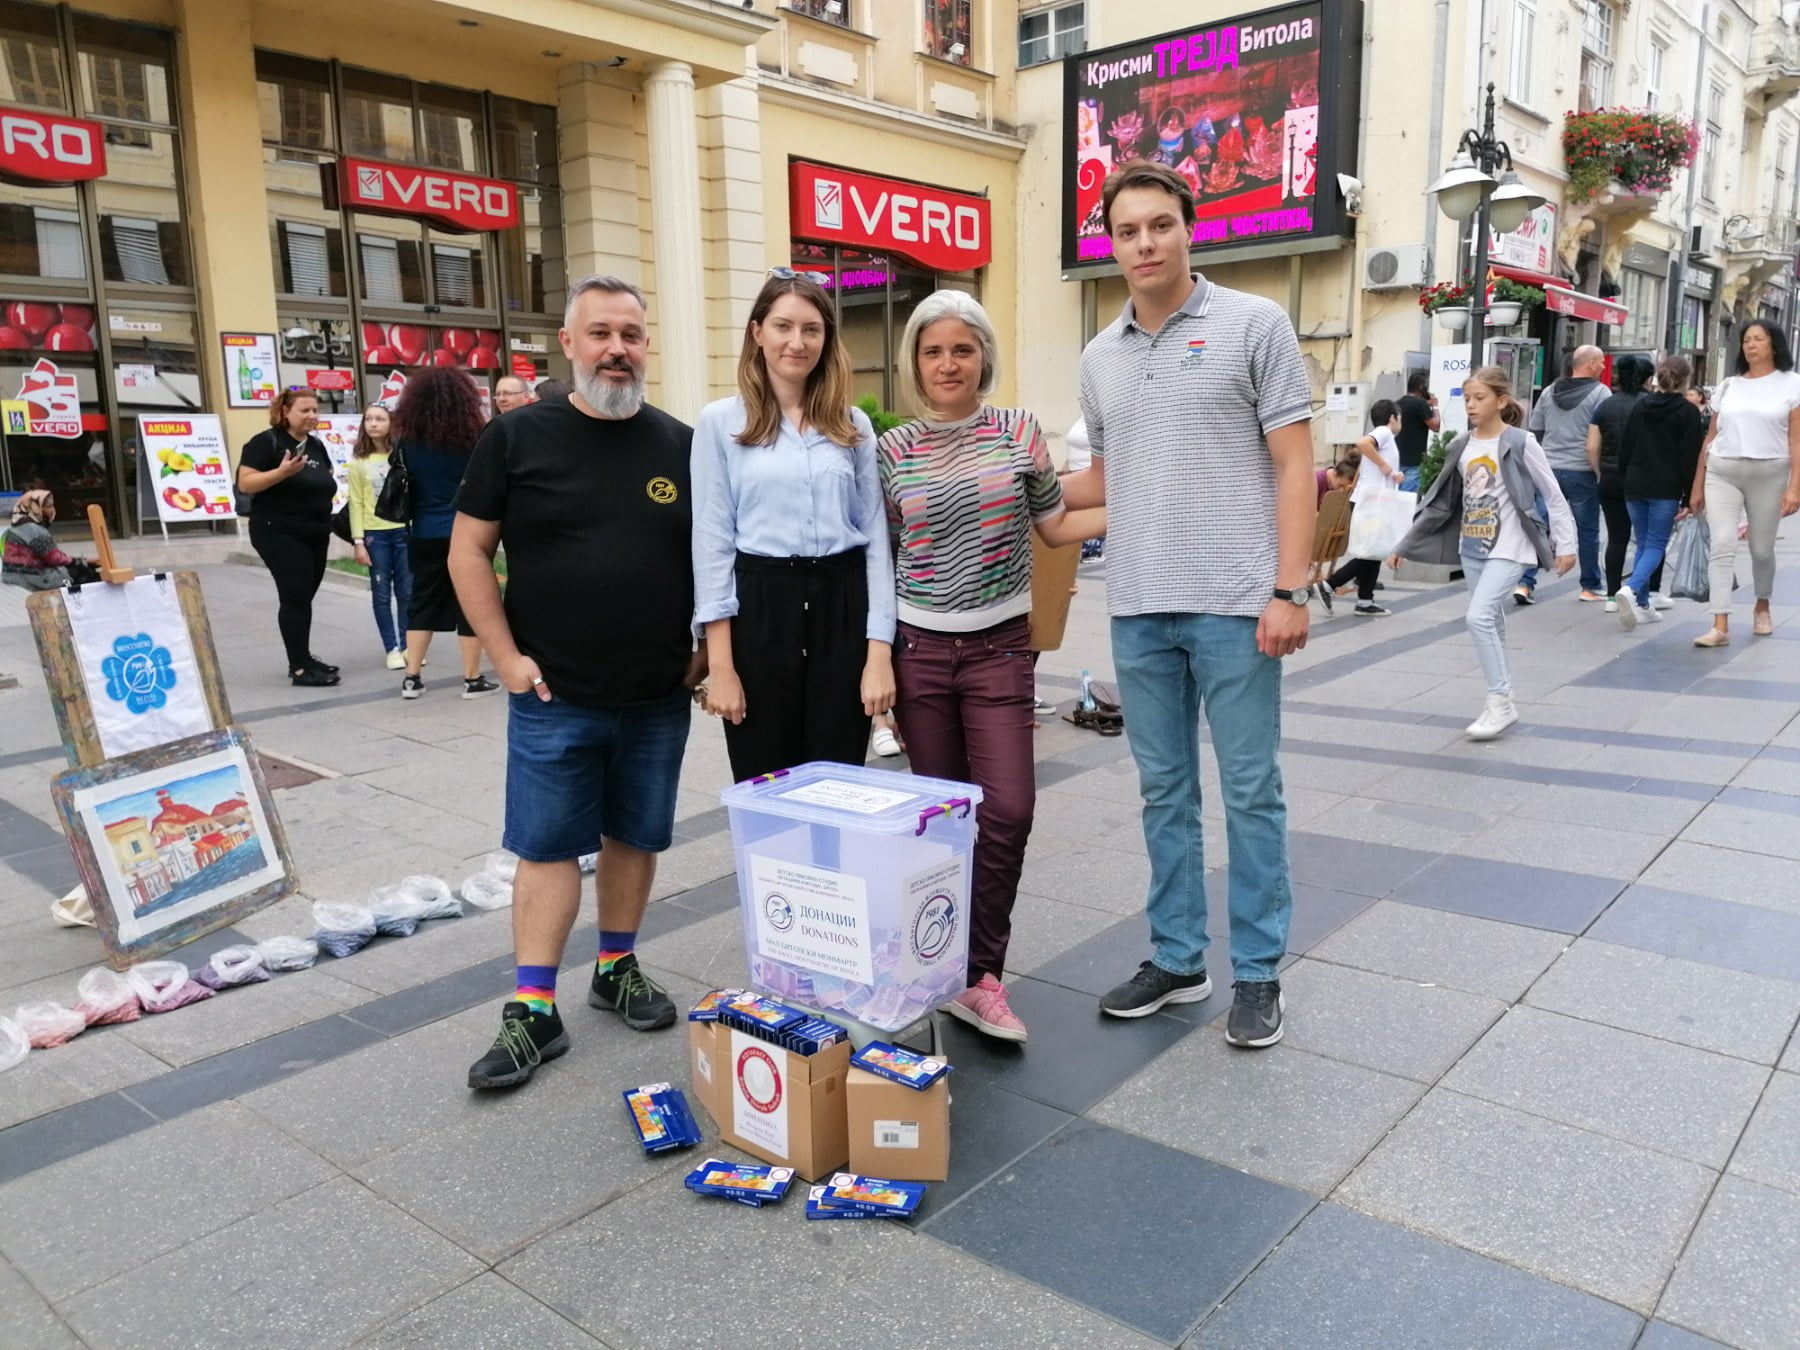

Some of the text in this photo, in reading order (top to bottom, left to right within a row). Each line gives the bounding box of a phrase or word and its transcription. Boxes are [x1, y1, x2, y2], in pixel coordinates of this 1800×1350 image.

[1087, 17, 1313, 88] Крисми ТРЕЈД Битола
[385, 170, 509, 218] VERO
[849, 185, 980, 250] VERO
[226, 337, 254, 345] АКЦИЈА
[31, 422, 78, 433] VERO
[147, 423, 188, 434] АКЦИЈА
[800, 904, 856, 928] ДОНАЦИИ
[801, 925, 859, 949] DONATIONS
